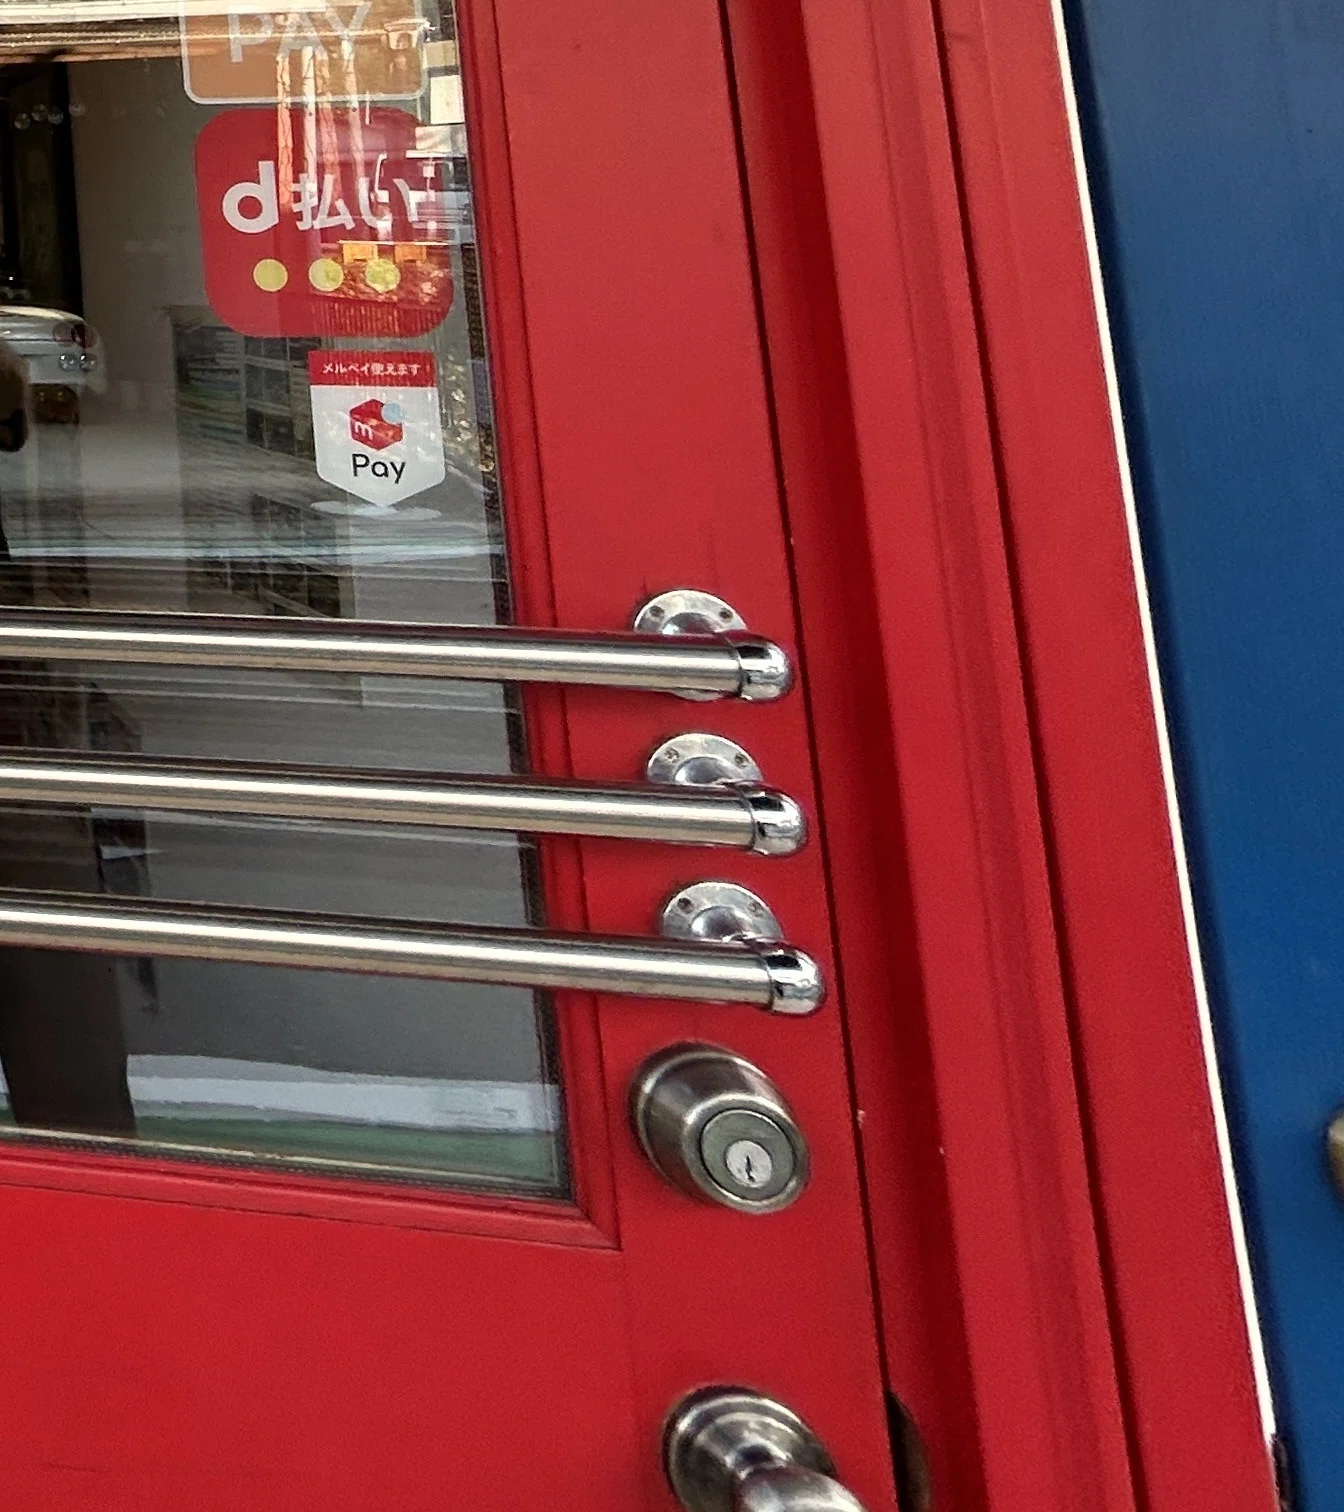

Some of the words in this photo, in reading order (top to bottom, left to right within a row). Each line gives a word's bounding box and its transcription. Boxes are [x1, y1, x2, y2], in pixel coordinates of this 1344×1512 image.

[226, 1, 372, 63] PAY
[222, 160, 419, 234] d払い
[351, 453, 407, 484] Pay
